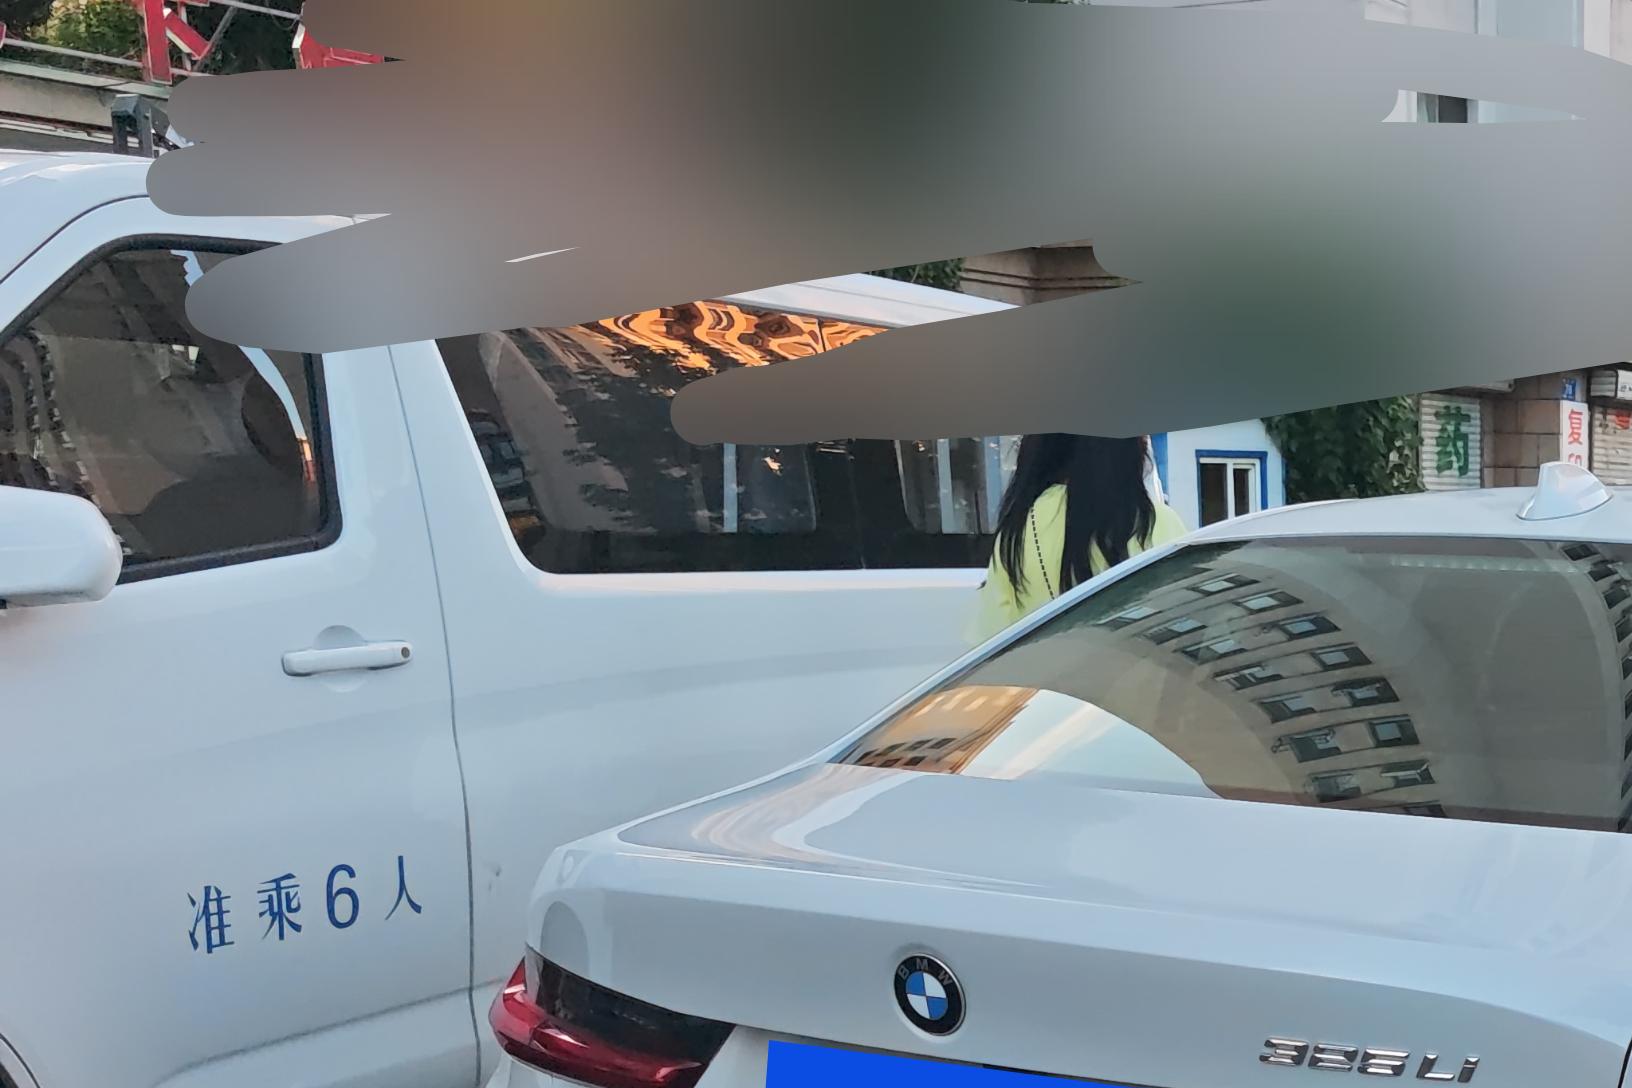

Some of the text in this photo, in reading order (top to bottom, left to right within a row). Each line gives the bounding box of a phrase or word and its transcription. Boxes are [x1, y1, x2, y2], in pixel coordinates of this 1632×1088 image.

[1433, 405, 1471, 477] 药
[187, 855, 422, 954] 准乘6人
[898, 957, 954, 987] BMW
[1258, 1036, 1480, 1084] 325Li
